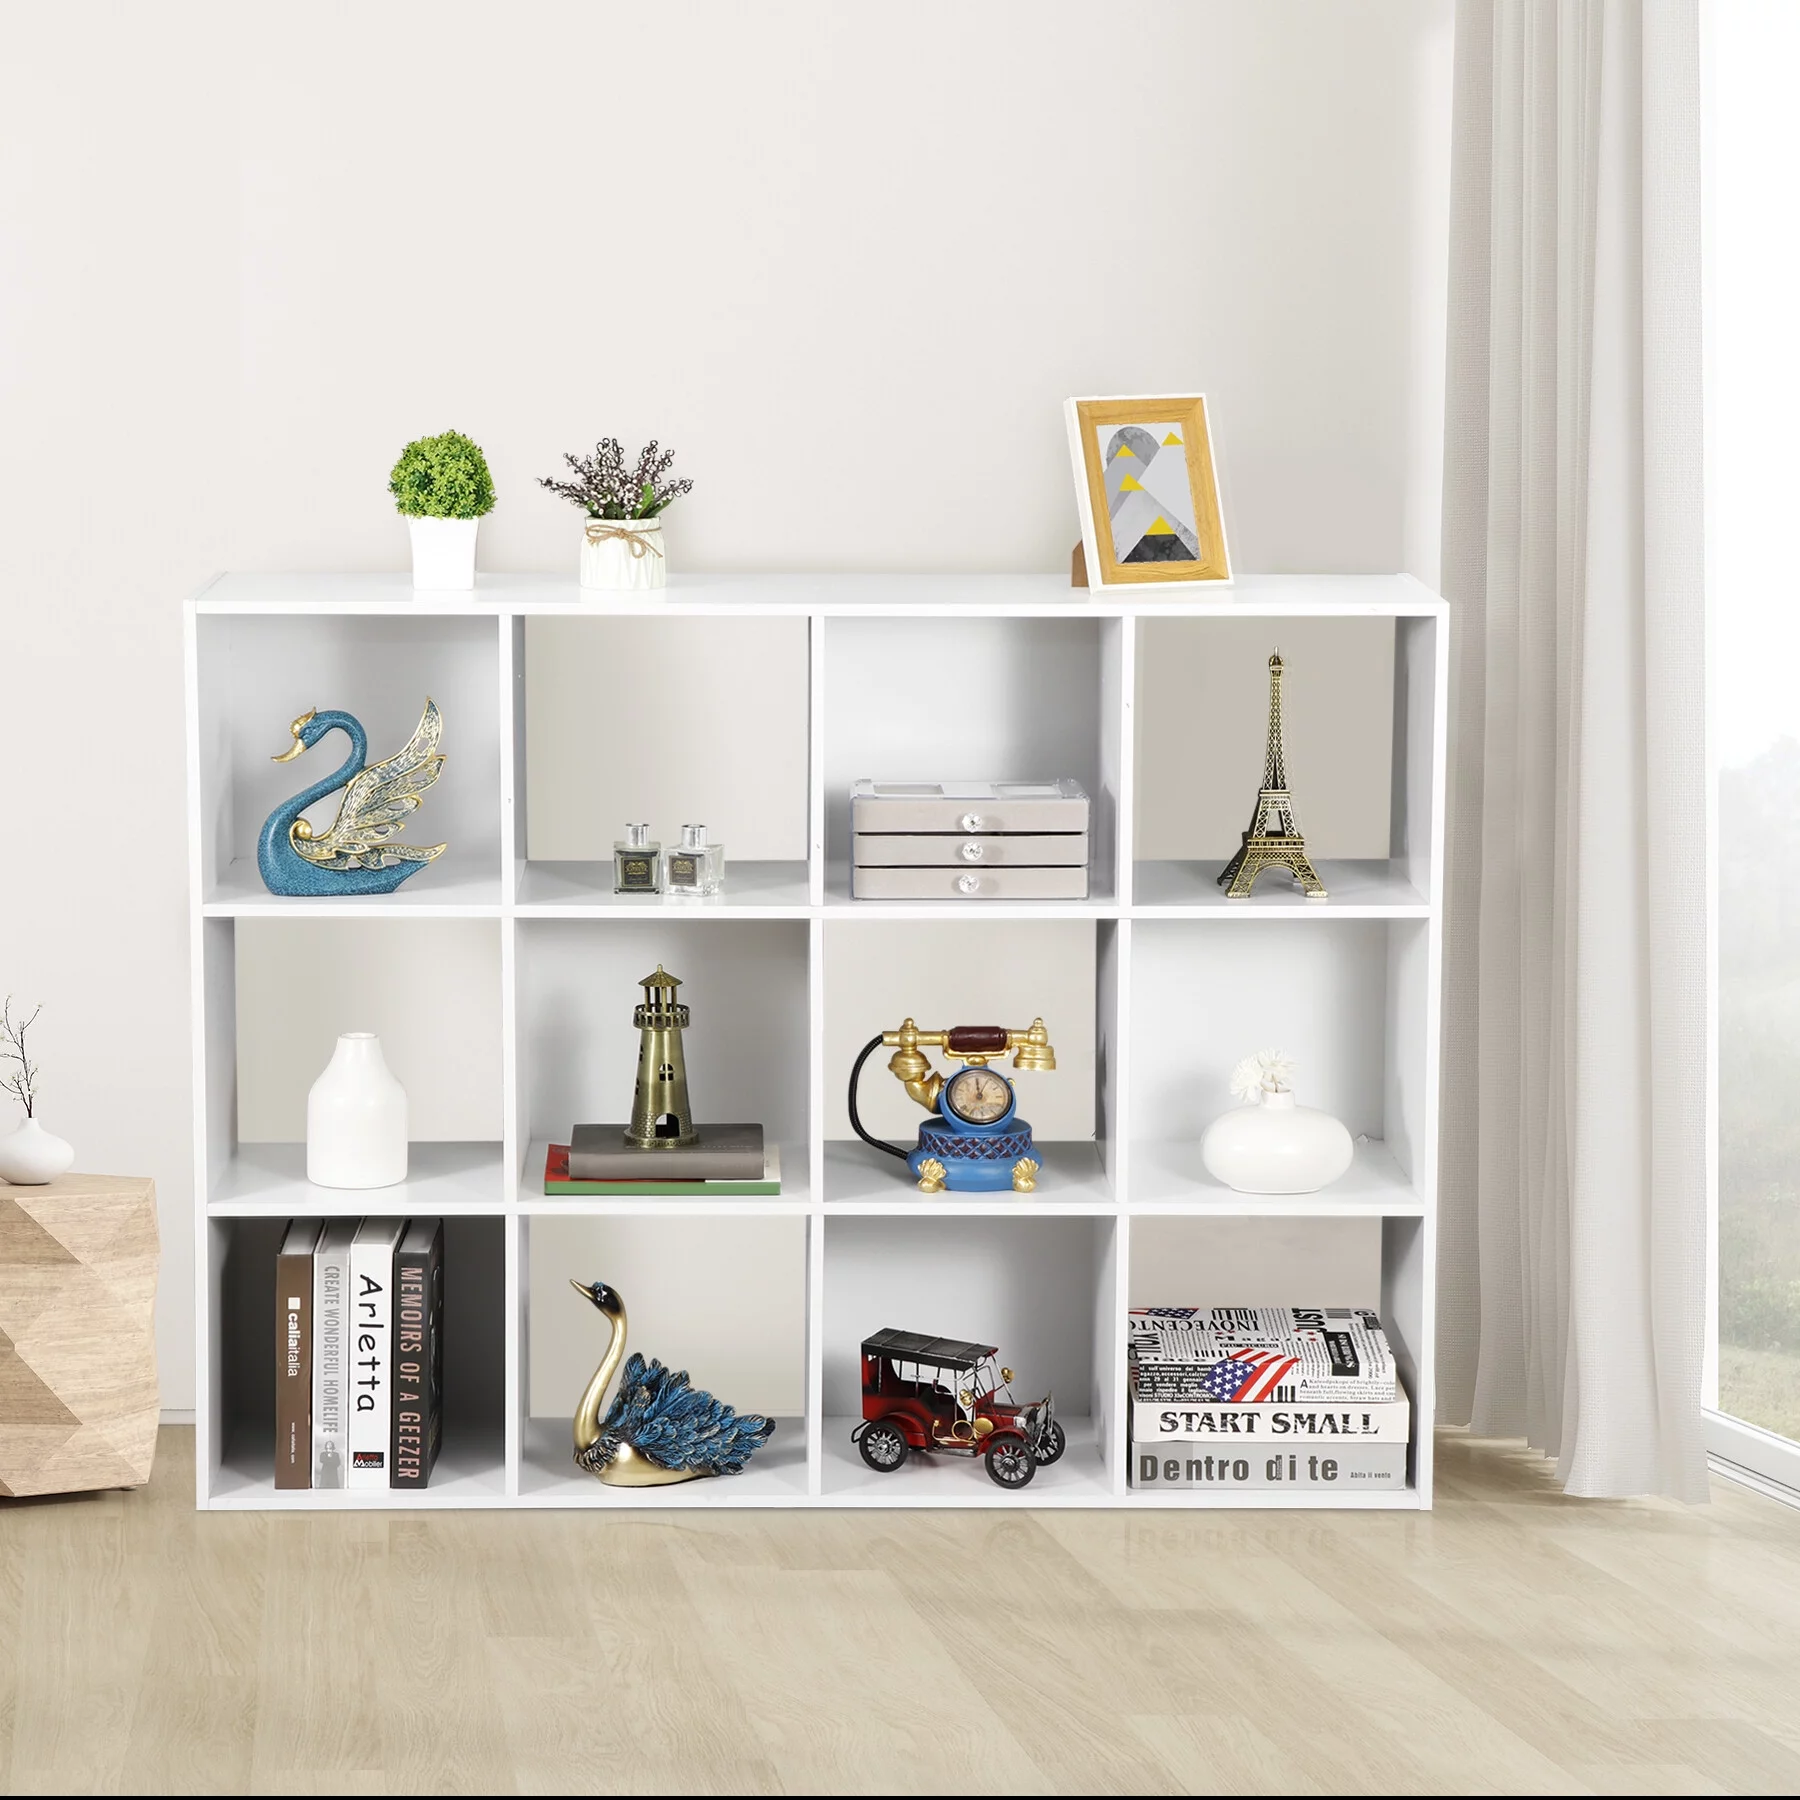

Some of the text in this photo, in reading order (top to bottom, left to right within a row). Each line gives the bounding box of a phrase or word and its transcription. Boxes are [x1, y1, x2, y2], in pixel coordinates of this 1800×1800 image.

[288, 1313, 300, 1377] caliaitalia
[322, 1265, 341, 1433] CREATE WONDERFUL HOMELIFE
[357, 1274, 384, 1412] Arletta
[1291, 1308, 1327, 1333] JUST
[397, 1267, 423, 1479] MEMOIRS OF A GEEZER
[1159, 1411, 1380, 1434] START SMALL
[1139, 1454, 1250, 1482] Dentro
[1266, 1454, 1297, 1481] di
[1308, 1455, 1338, 1482] te
